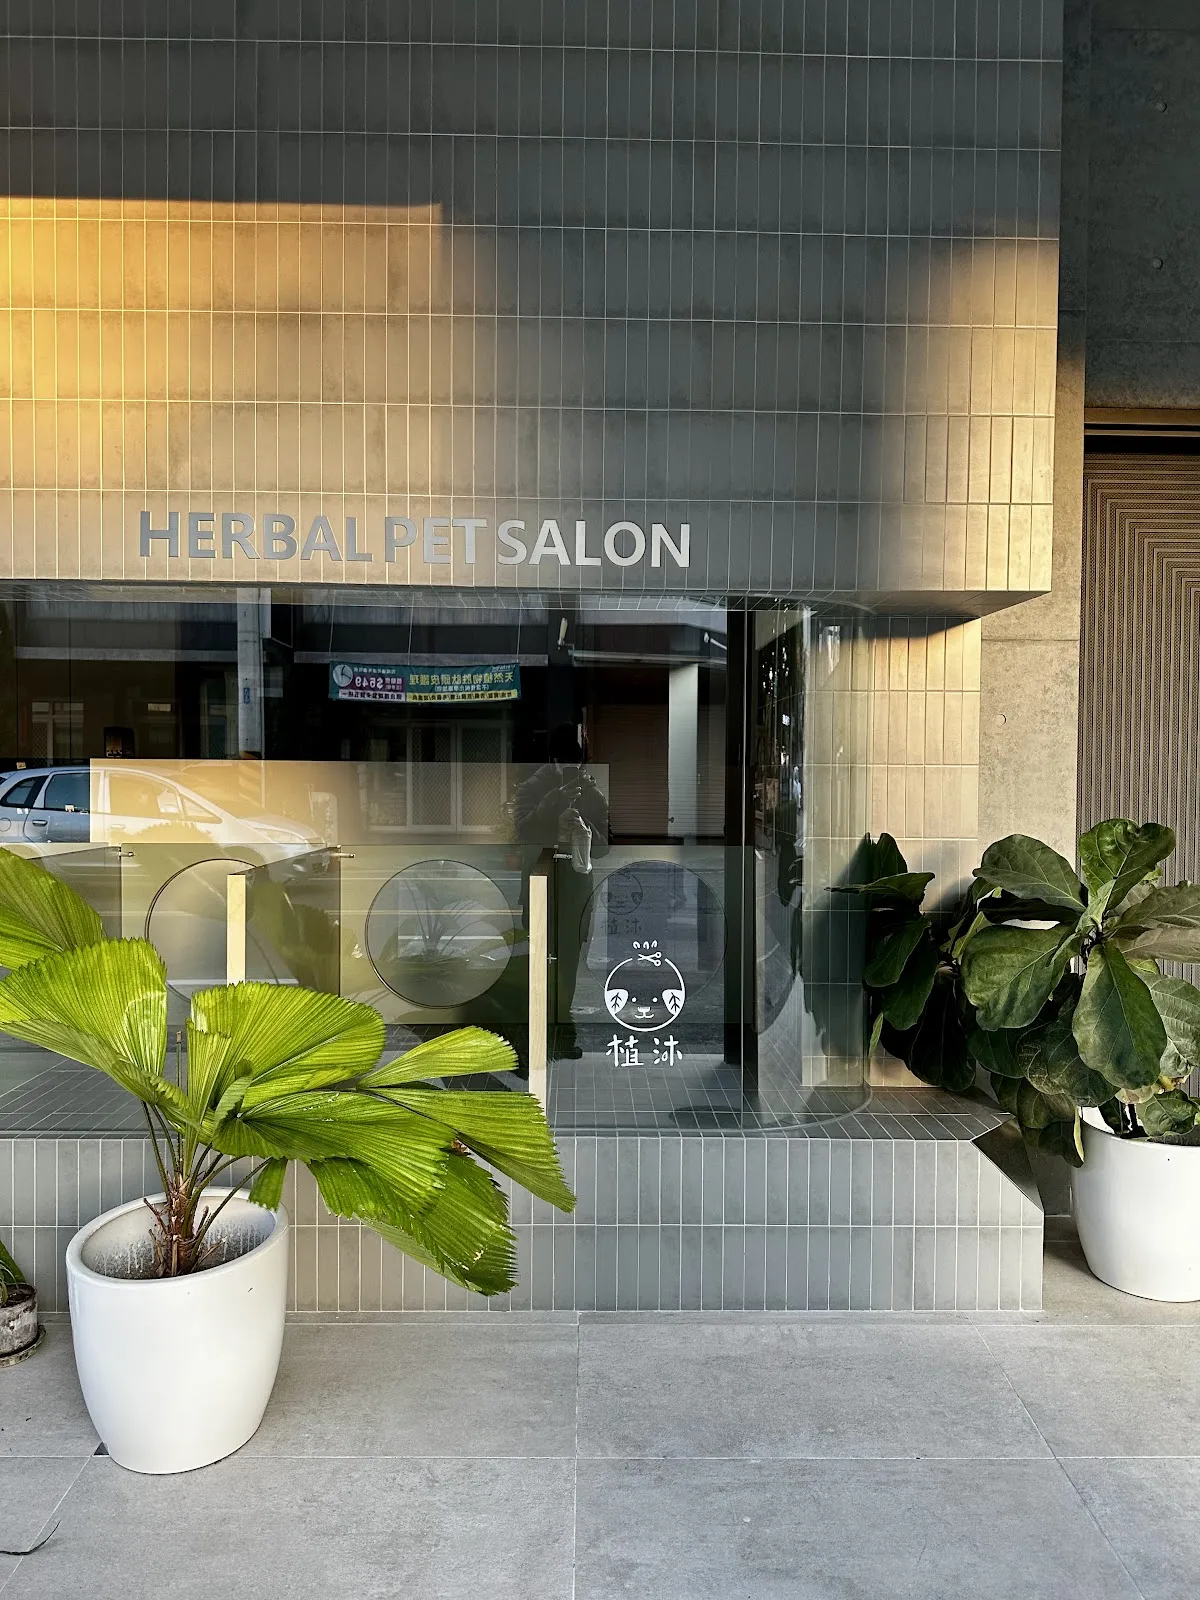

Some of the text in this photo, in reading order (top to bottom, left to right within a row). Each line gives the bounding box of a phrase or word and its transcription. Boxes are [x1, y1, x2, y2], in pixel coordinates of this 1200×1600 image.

[140, 511, 690, 568] HERBAL PET SALON
[605, 1034, 683, 1067] 植沐
